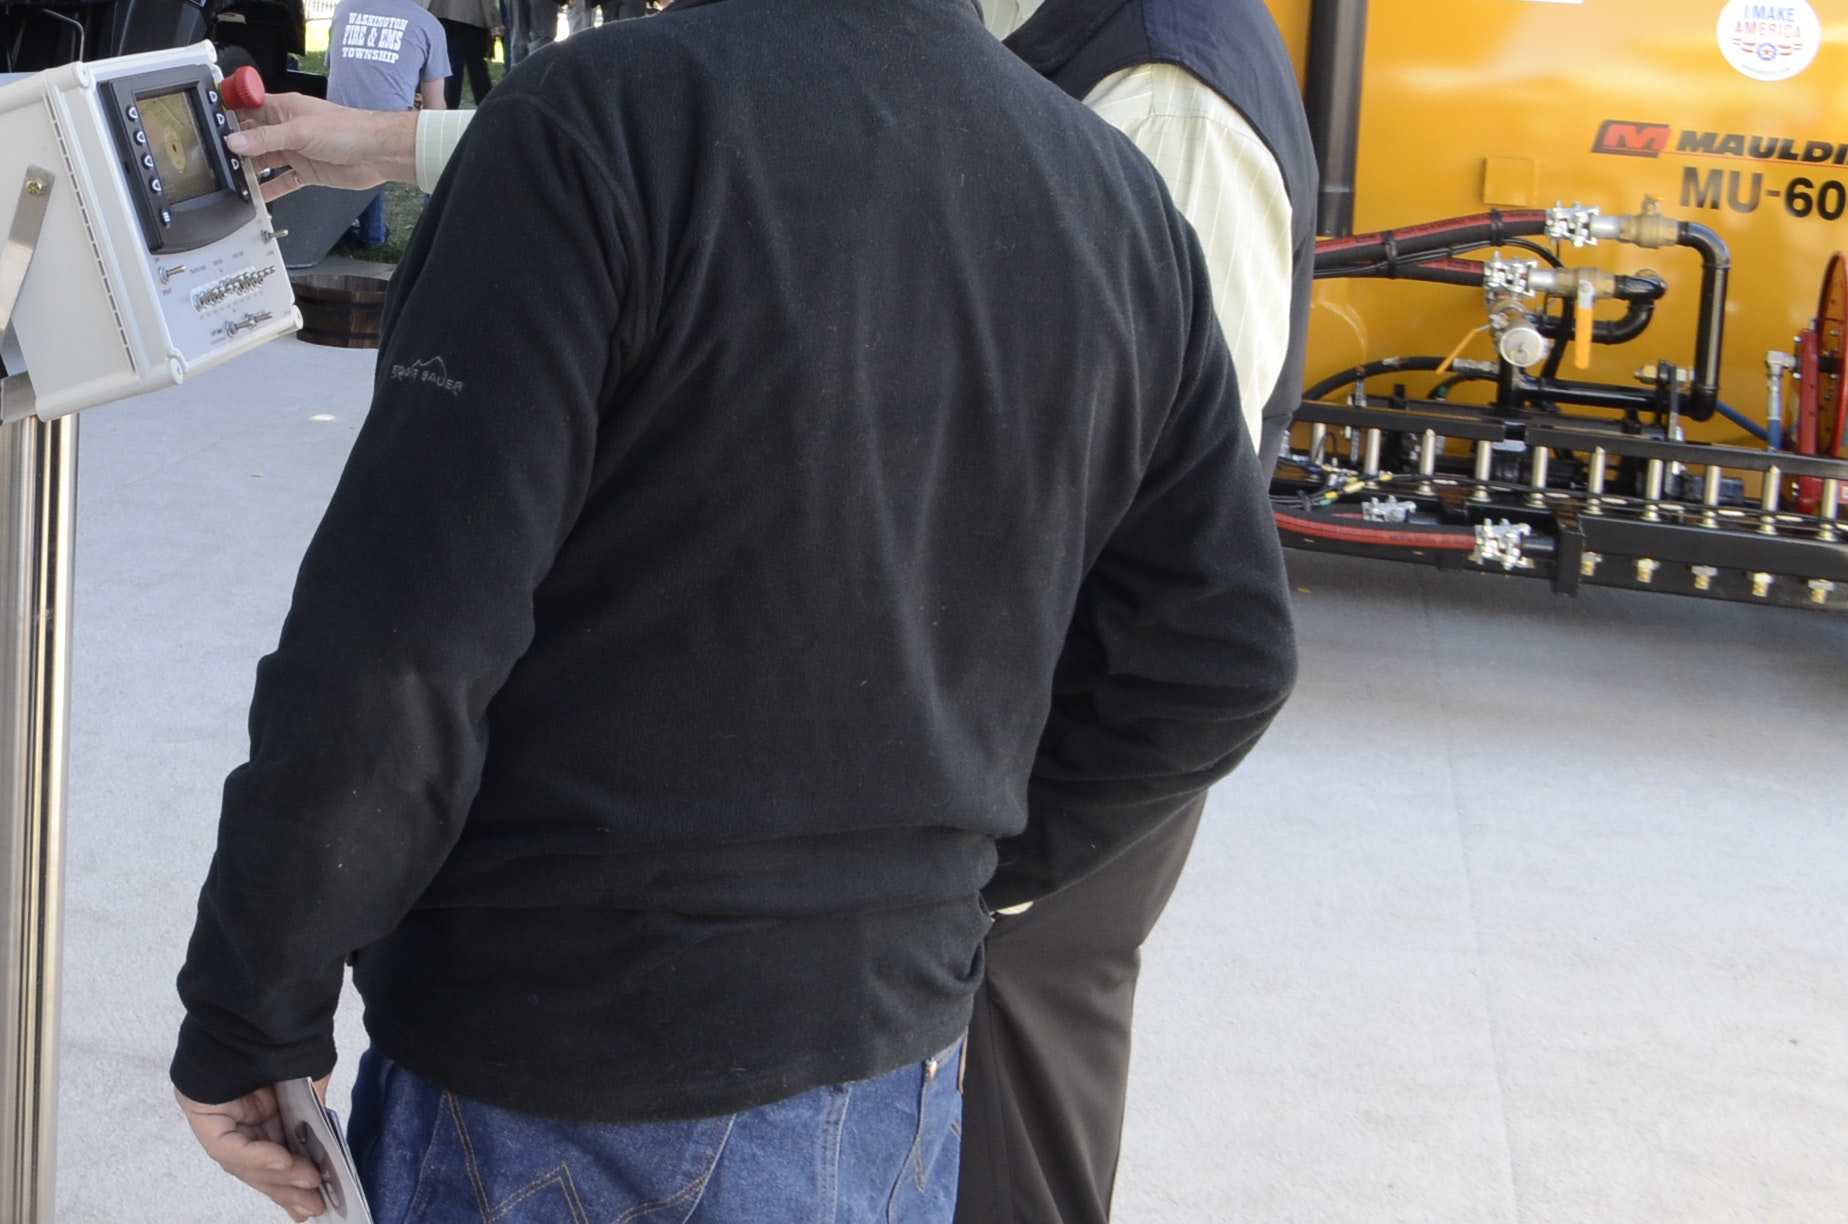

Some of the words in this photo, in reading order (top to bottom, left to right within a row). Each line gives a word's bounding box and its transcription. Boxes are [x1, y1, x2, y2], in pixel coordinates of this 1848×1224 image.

[349, 12, 408, 31] WASHINGTON
[1753, 4, 1795, 22] MAKE
[342, 24, 368, 46] FIRE
[367, 27, 378, 47] &
[378, 28, 404, 51] EMS
[1735, 20, 1802, 39] AMERICA
[341, 46, 400, 64] TOWNSHIP
[1676, 129, 1848, 166] MAULDI
